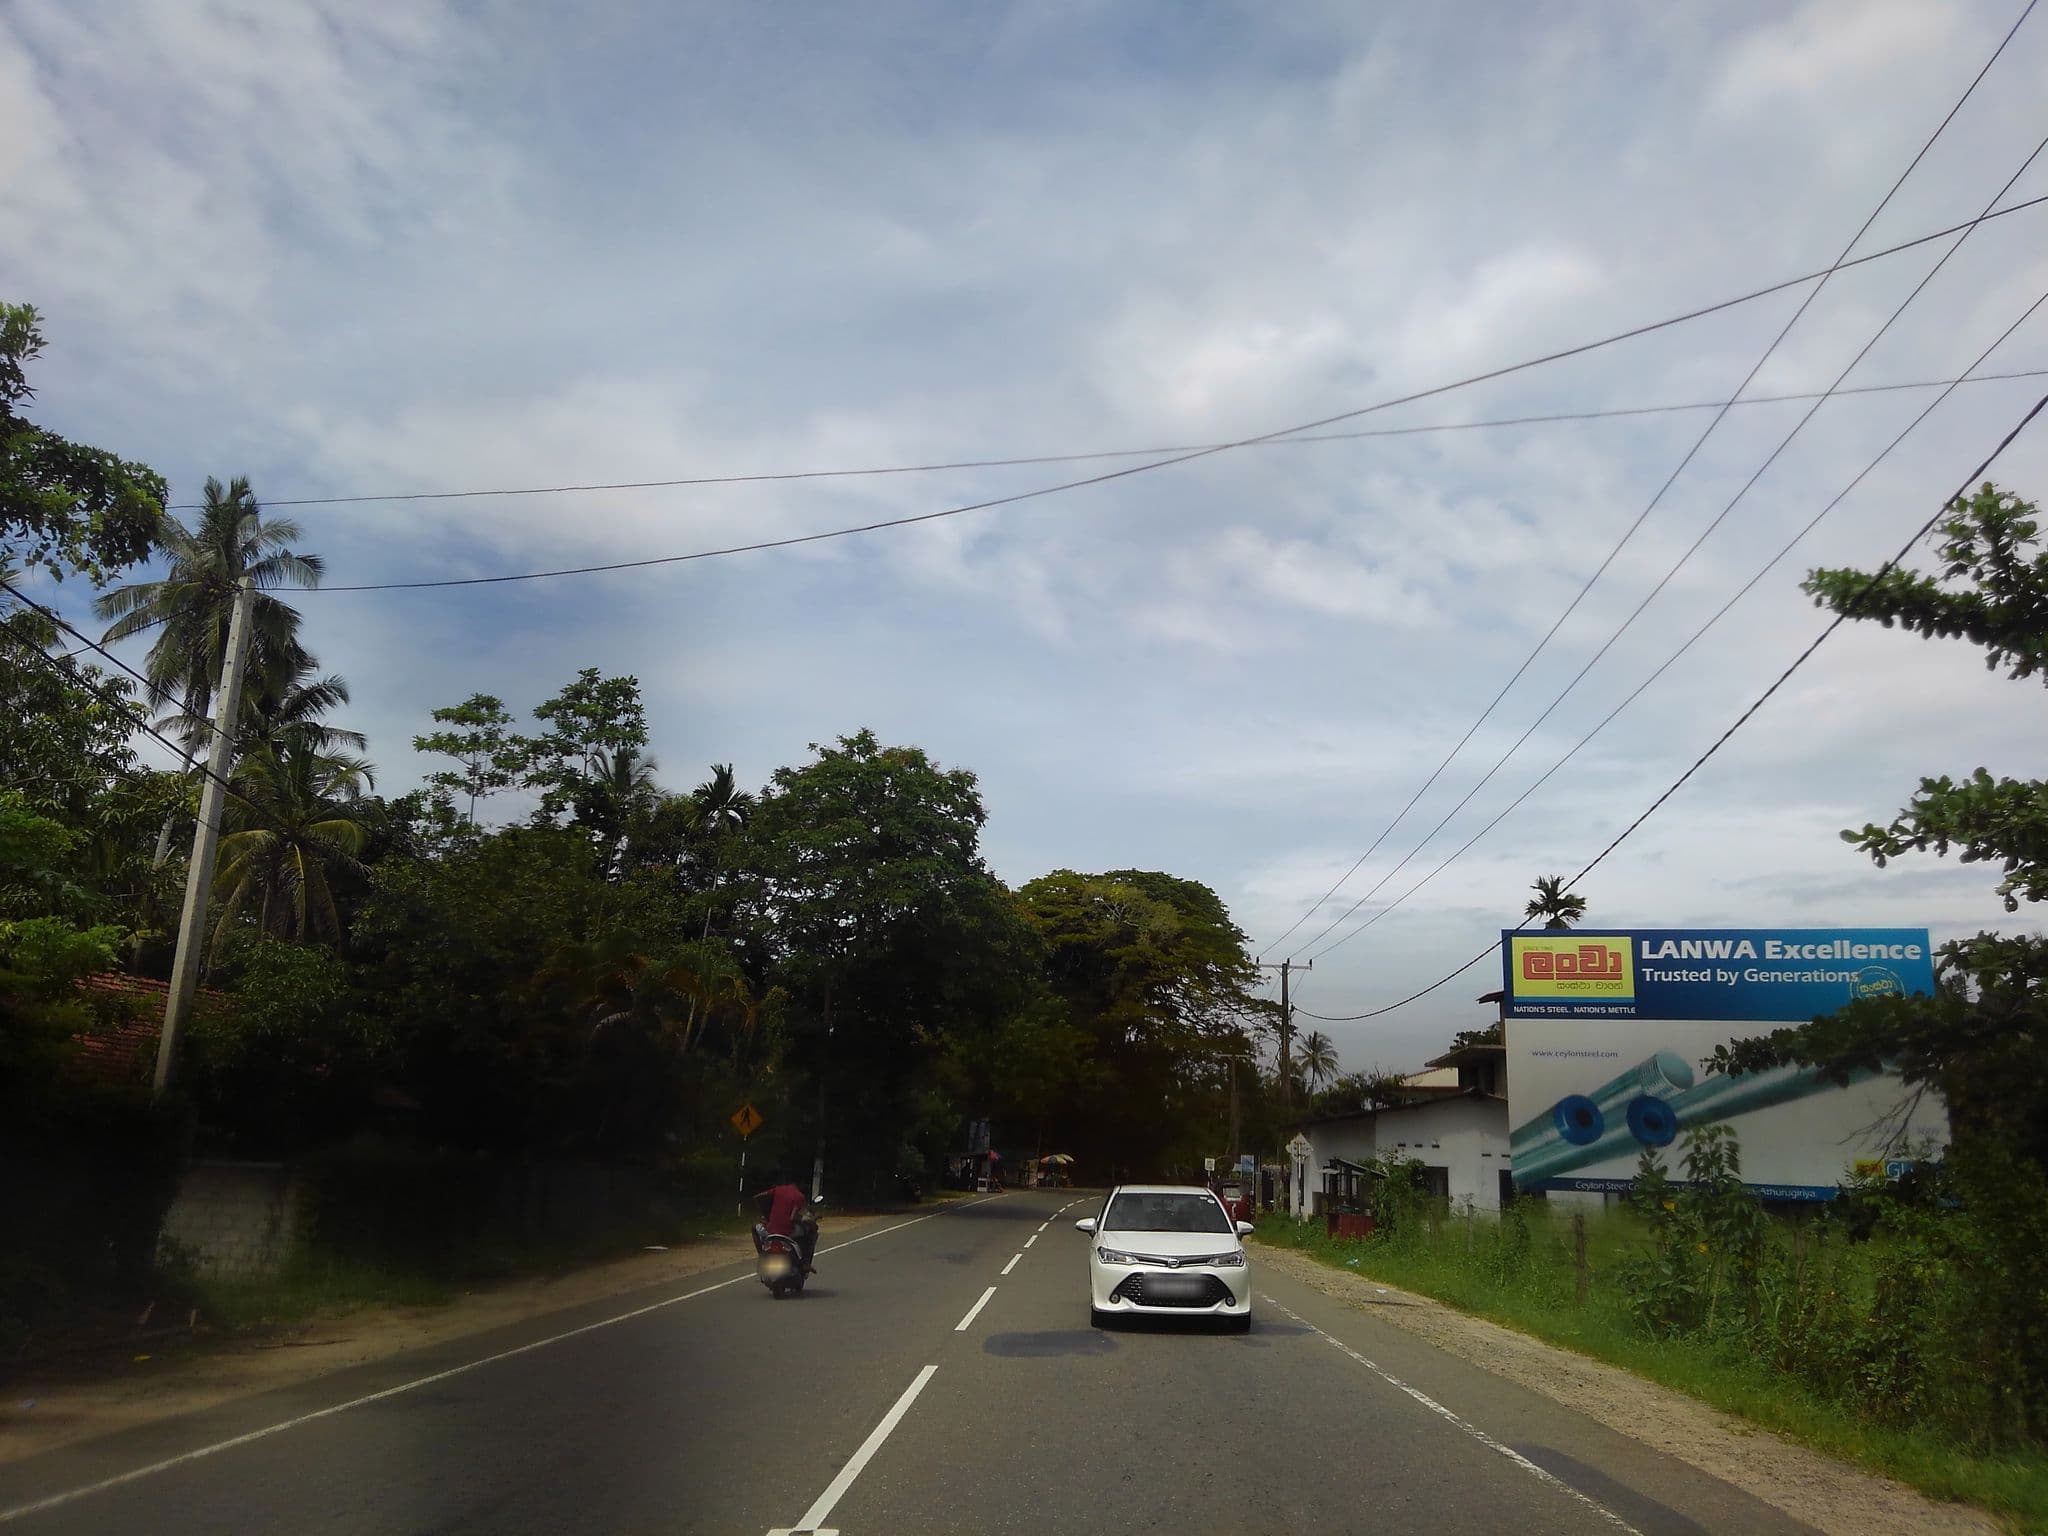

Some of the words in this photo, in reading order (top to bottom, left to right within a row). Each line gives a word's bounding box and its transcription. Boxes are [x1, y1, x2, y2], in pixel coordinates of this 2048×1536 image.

[1641, 940, 1758, 959] LANWA
[1765, 940, 1922, 960] Excellence
[1641, 968, 1711, 982] Trusted
[1716, 968, 1739, 986] by
[1743, 968, 1859, 983] Generations
[1531, 1050, 1619, 1059] www.ceylonsteel.com
[1575, 1181, 1605, 1191] Ceylon
